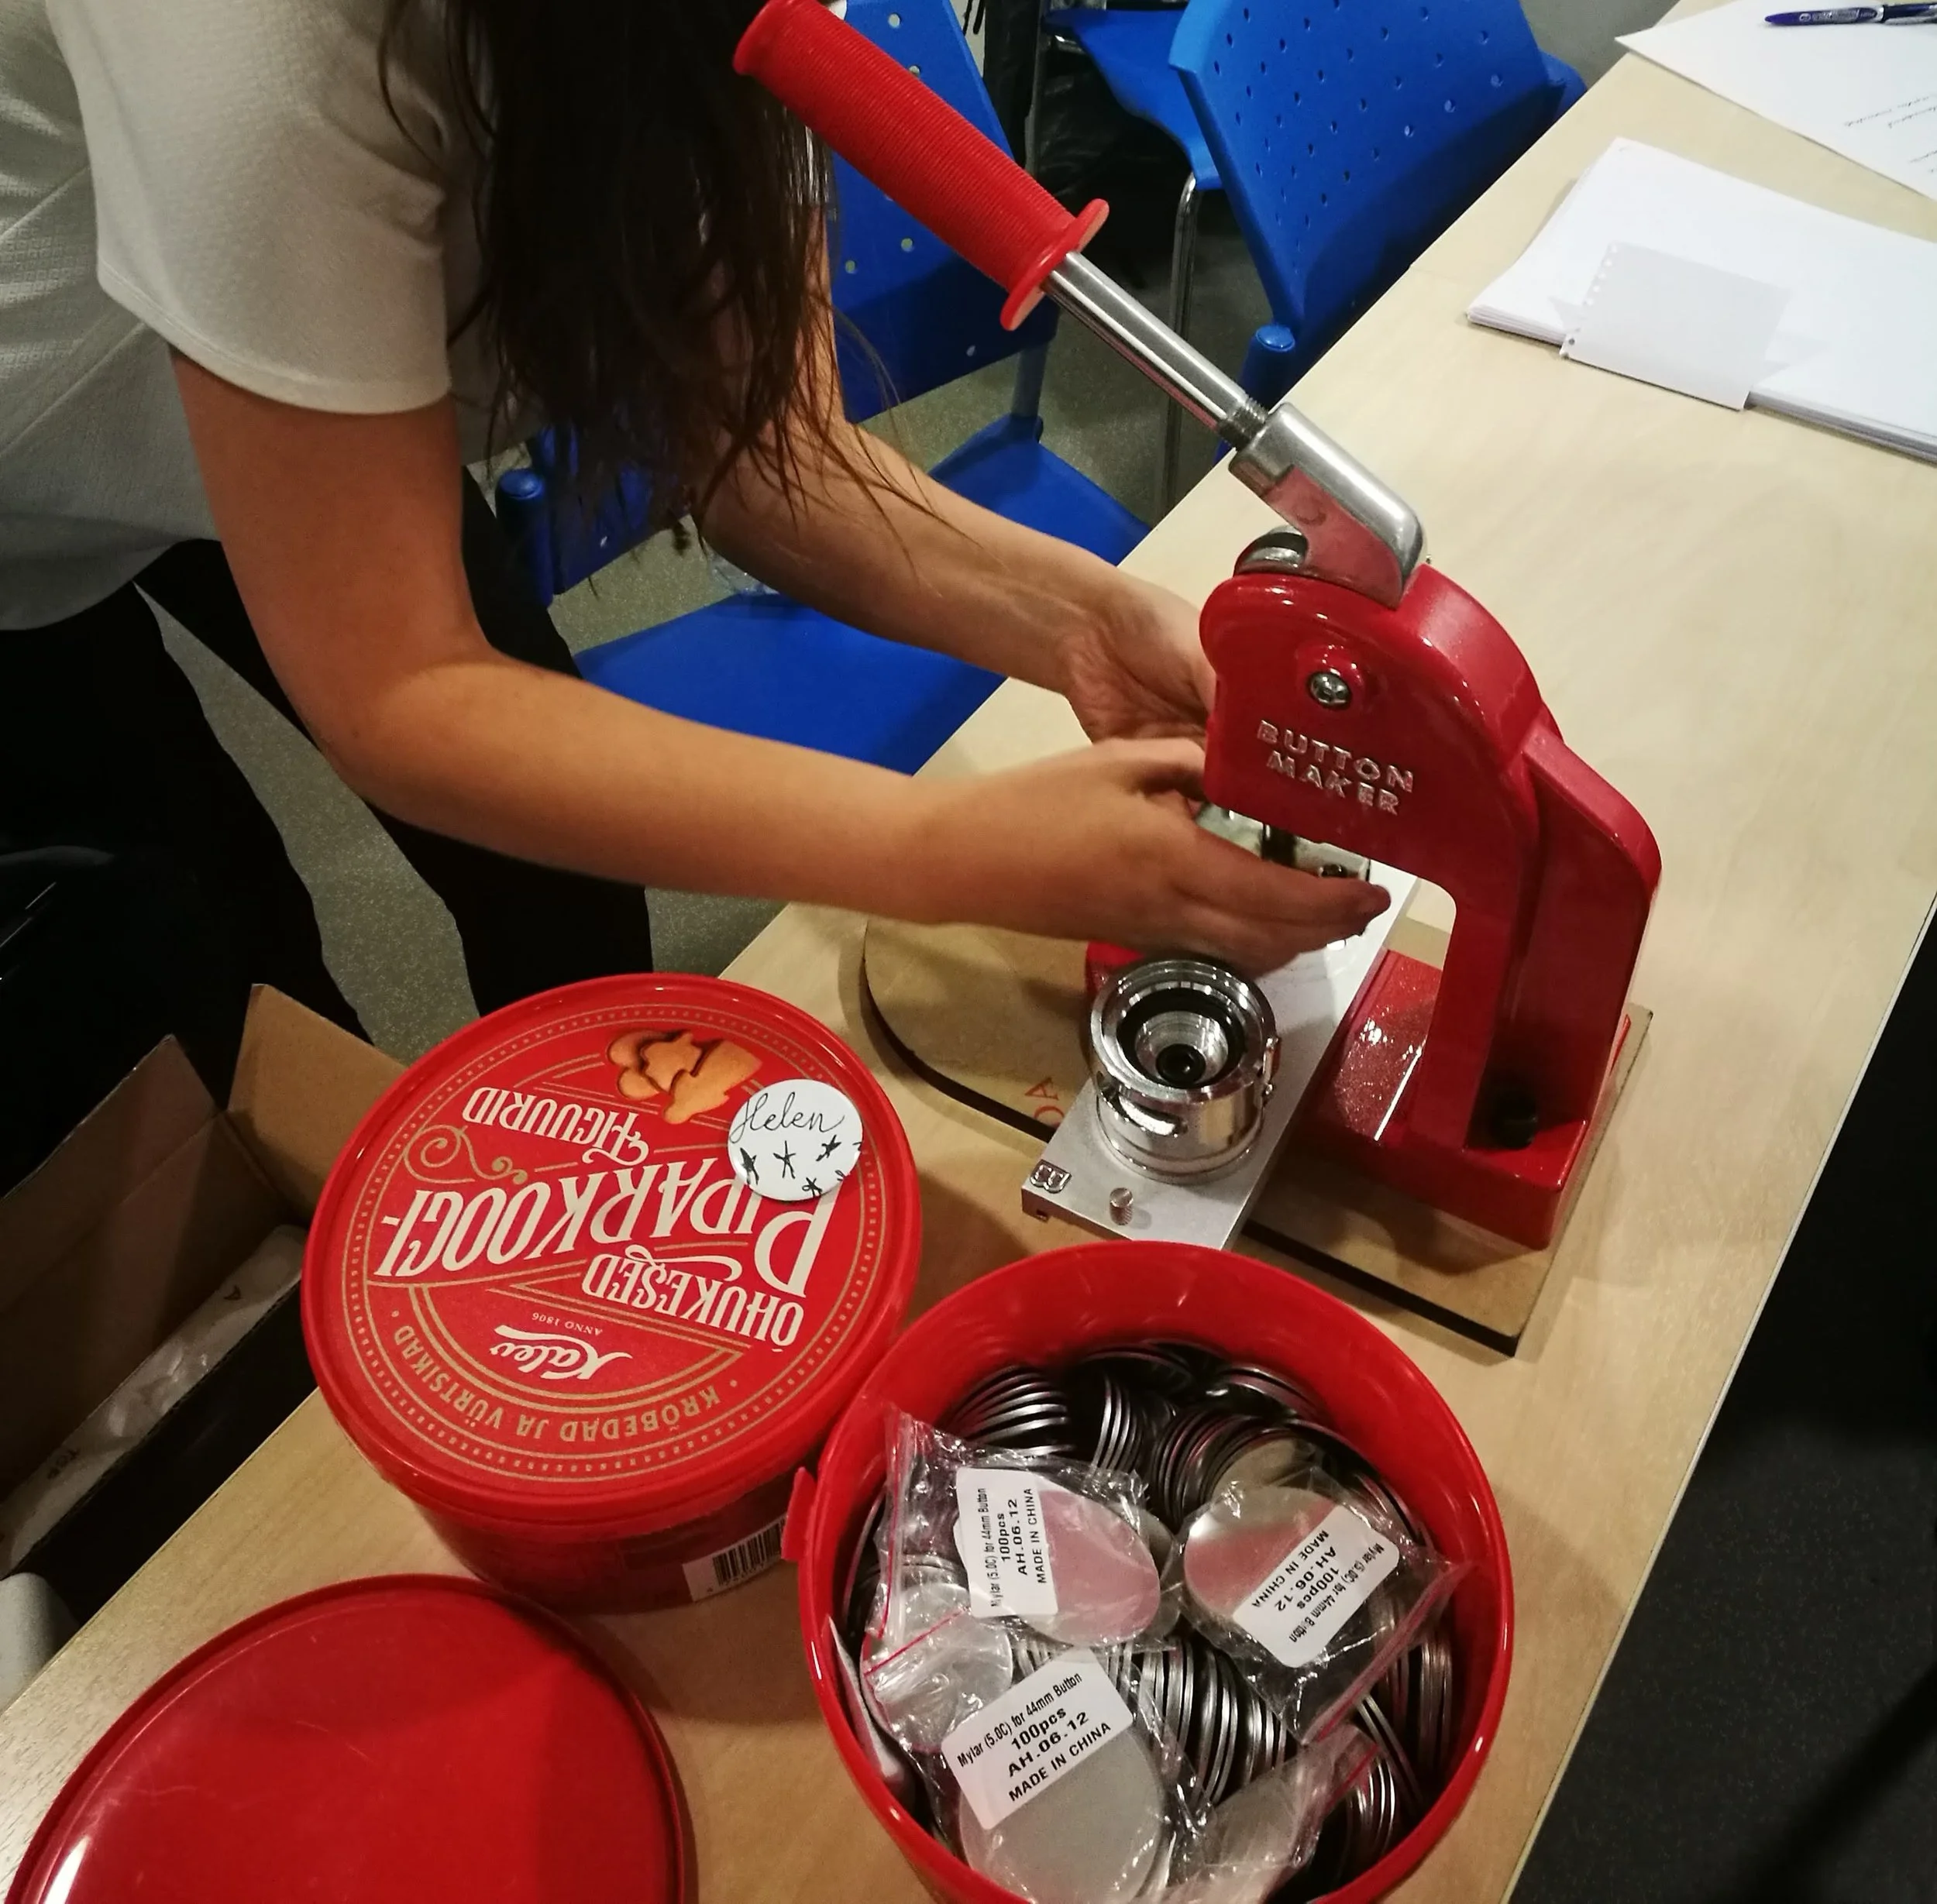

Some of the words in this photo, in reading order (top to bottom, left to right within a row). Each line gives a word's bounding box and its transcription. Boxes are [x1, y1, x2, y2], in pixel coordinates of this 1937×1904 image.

[1257, 720, 1413, 793] BUTTON
[1266, 750, 1399, 815] MAKER
[462, 1086, 649, 1166] FIGUURID
[729, 1091, 845, 1144] Helen
[532, 1311, 560, 1327] 1806
[565, 1320, 604, 1337] ANNO
[490, 1324, 634, 1380] Kalev
[394, 1325, 504, 1429] VÜRTSIKAD
[516, 1414, 549, 1439] JA
[559, 1385, 721, 1442] KRÕBEDAD
[977, 1488, 989, 1513] Button
[1024, 1488, 1038, 1525] CHINA
[982, 1516, 993, 1539] 44mm
[984, 1541, 995, 1553] for
[997, 1513, 1011, 1562] 100pcs
[1008, 1498, 1028, 1576] AH.06.12
[1030, 1531, 1041, 1543] IN
[1299, 1530, 1330, 1561] MADE
[1032, 1548, 1048, 1583] MADE
[1274, 1546, 1337, 1612] AH.06.12
[1285, 1561, 1299, 1575] IN
[1252, 1575, 1285, 1608] CHINA
[1296, 1566, 1340, 1610] 100pcs
[1310, 1593, 1337, 1619] 44mm
[1334, 1582, 1347, 1596] for
[957, 1742, 985, 1767] Mylar
[984, 1722, 1013, 1749] (5.0C)
[1010, 1712, 1026, 1727] for
[1025, 1693, 1055, 1717] 44mm
[1053, 1672, 1083, 1697] Button
[1010, 1707, 1067, 1751] 100pcs
[1007, 1711, 1090, 1777] AH.06.12
[1009, 1767, 1049, 1801] MADE
[1050, 1753, 1067, 1771] IN
[1068, 1721, 1111, 1757] CHINA
